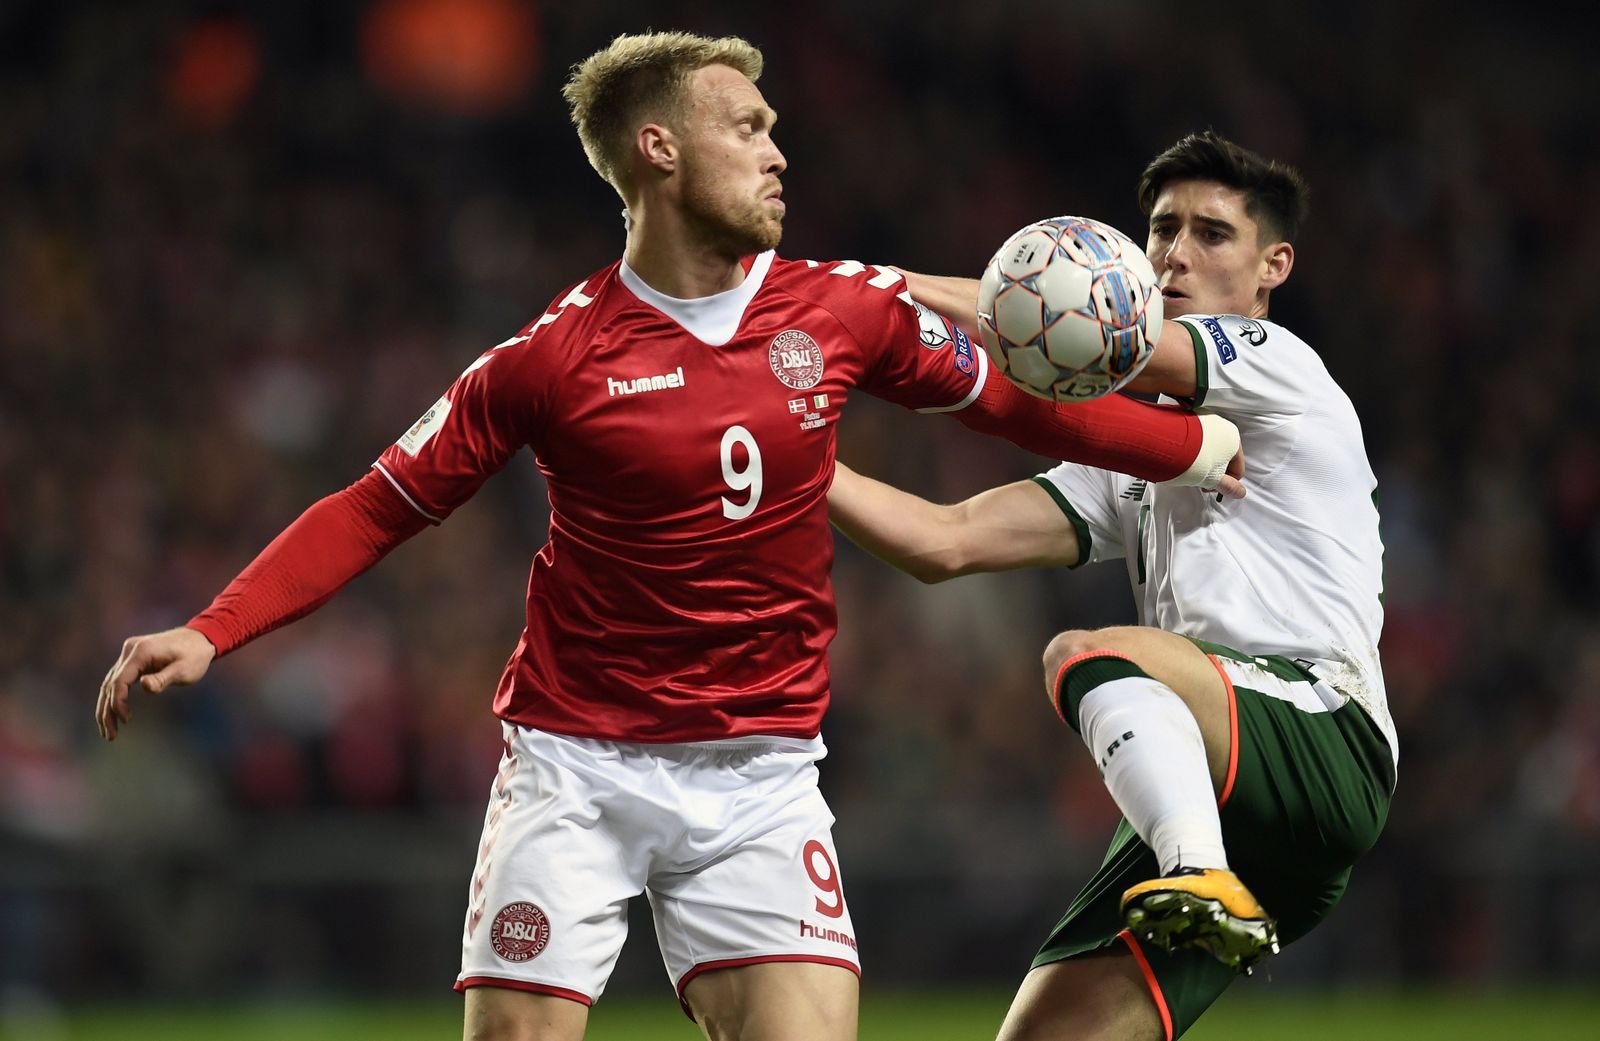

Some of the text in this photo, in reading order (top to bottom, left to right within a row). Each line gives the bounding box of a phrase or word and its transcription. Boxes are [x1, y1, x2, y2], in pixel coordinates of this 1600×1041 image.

[780, 350, 813, 368] DBU
[607, 366, 685, 396] hummel
[793, 378, 814, 388] 1889
[720, 425, 763, 520] 9
[803, 839, 843, 918] 9
[501, 921, 538, 941] DBU
[503, 950, 528, 961] 1889
